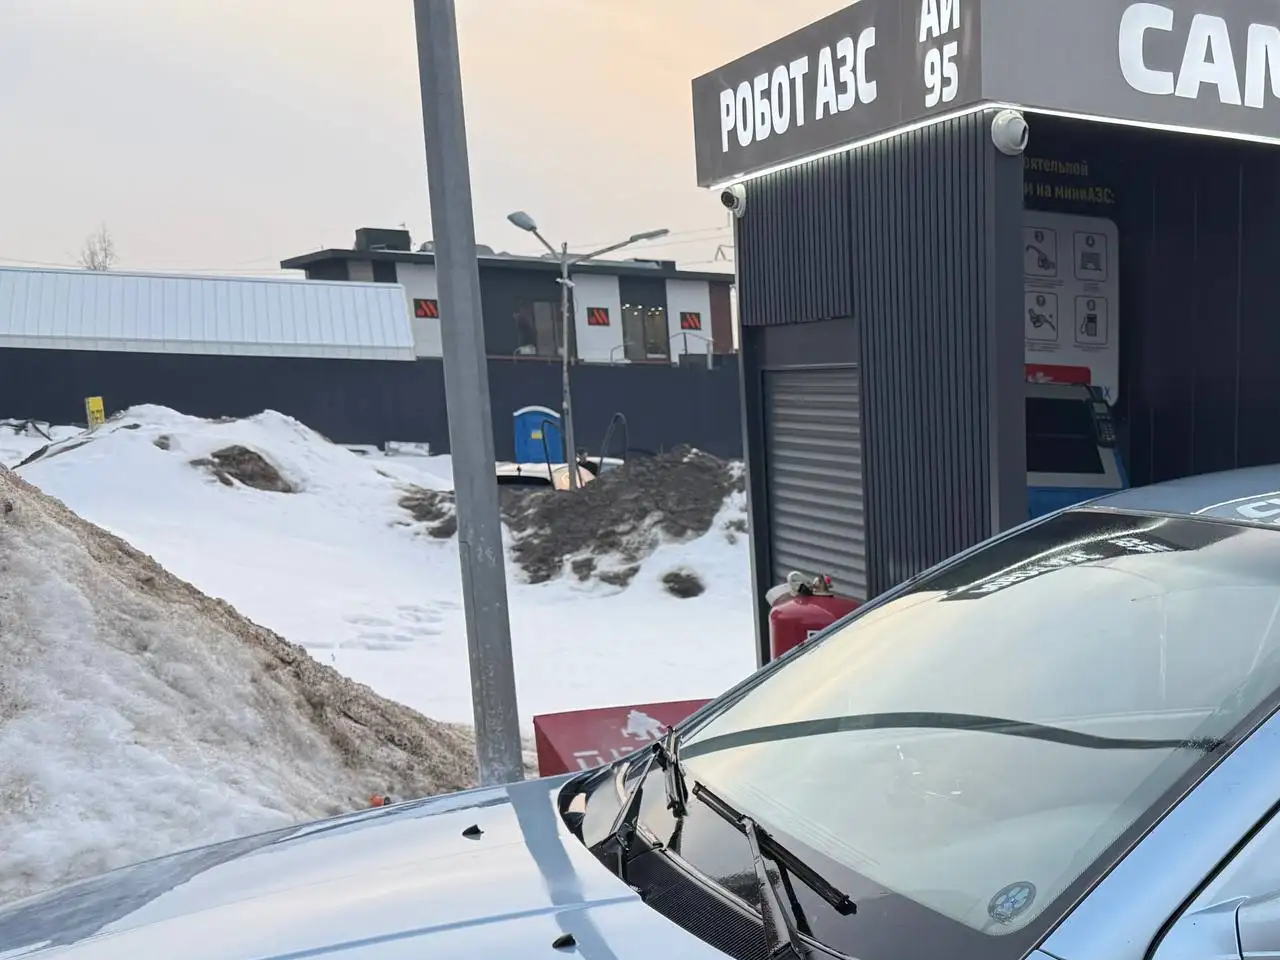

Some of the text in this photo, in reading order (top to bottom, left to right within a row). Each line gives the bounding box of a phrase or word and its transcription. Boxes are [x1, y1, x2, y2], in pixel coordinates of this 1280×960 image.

[919, 0, 961, 43] АИ
[720, 26, 877, 153] РОБОТ АЗС
[924, 41, 959, 108] 95
[1023, 156, 1088, 176] оятельной
